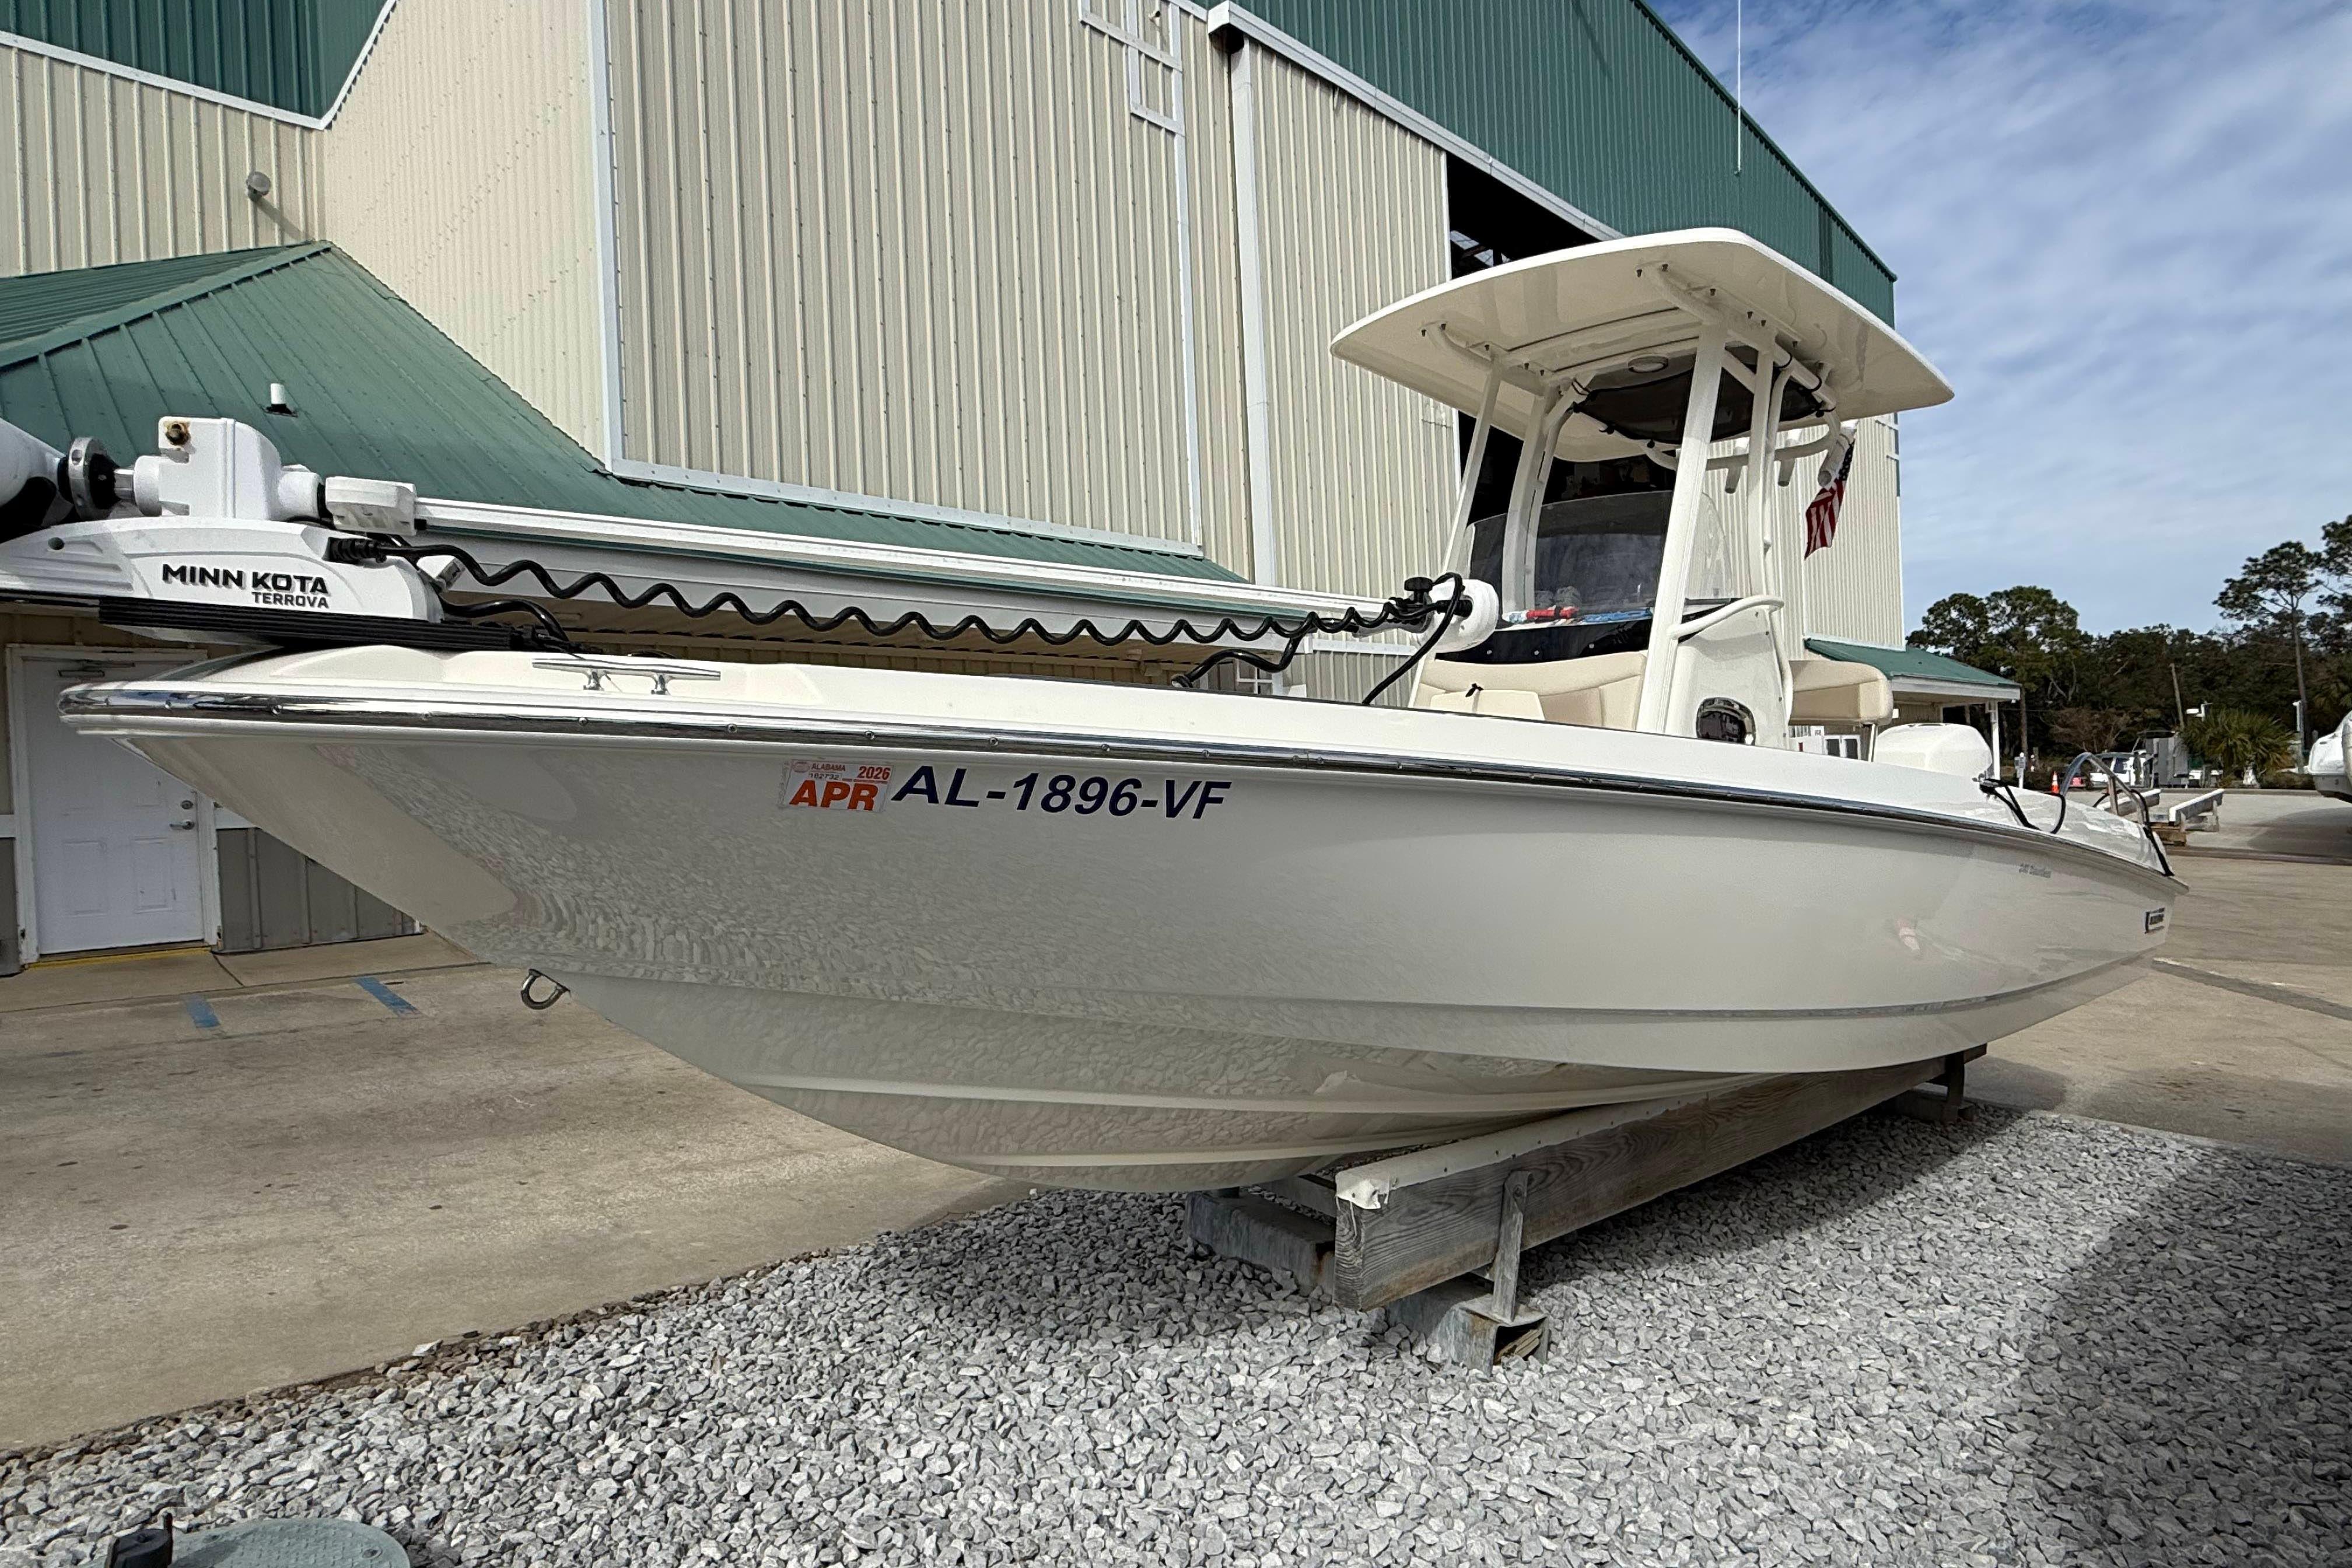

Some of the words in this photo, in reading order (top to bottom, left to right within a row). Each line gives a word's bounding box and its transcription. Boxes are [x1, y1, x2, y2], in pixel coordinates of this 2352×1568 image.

[162, 564, 243, 588] MINN
[252, 572, 329, 594] KOTA
[253, 592, 329, 608] TERROVA
[811, 763, 846, 771] ALABAMA
[857, 766, 891, 780] 2026
[789, 780, 879, 811] APR
[891, 765, 1231, 820] AL-1896-VF
